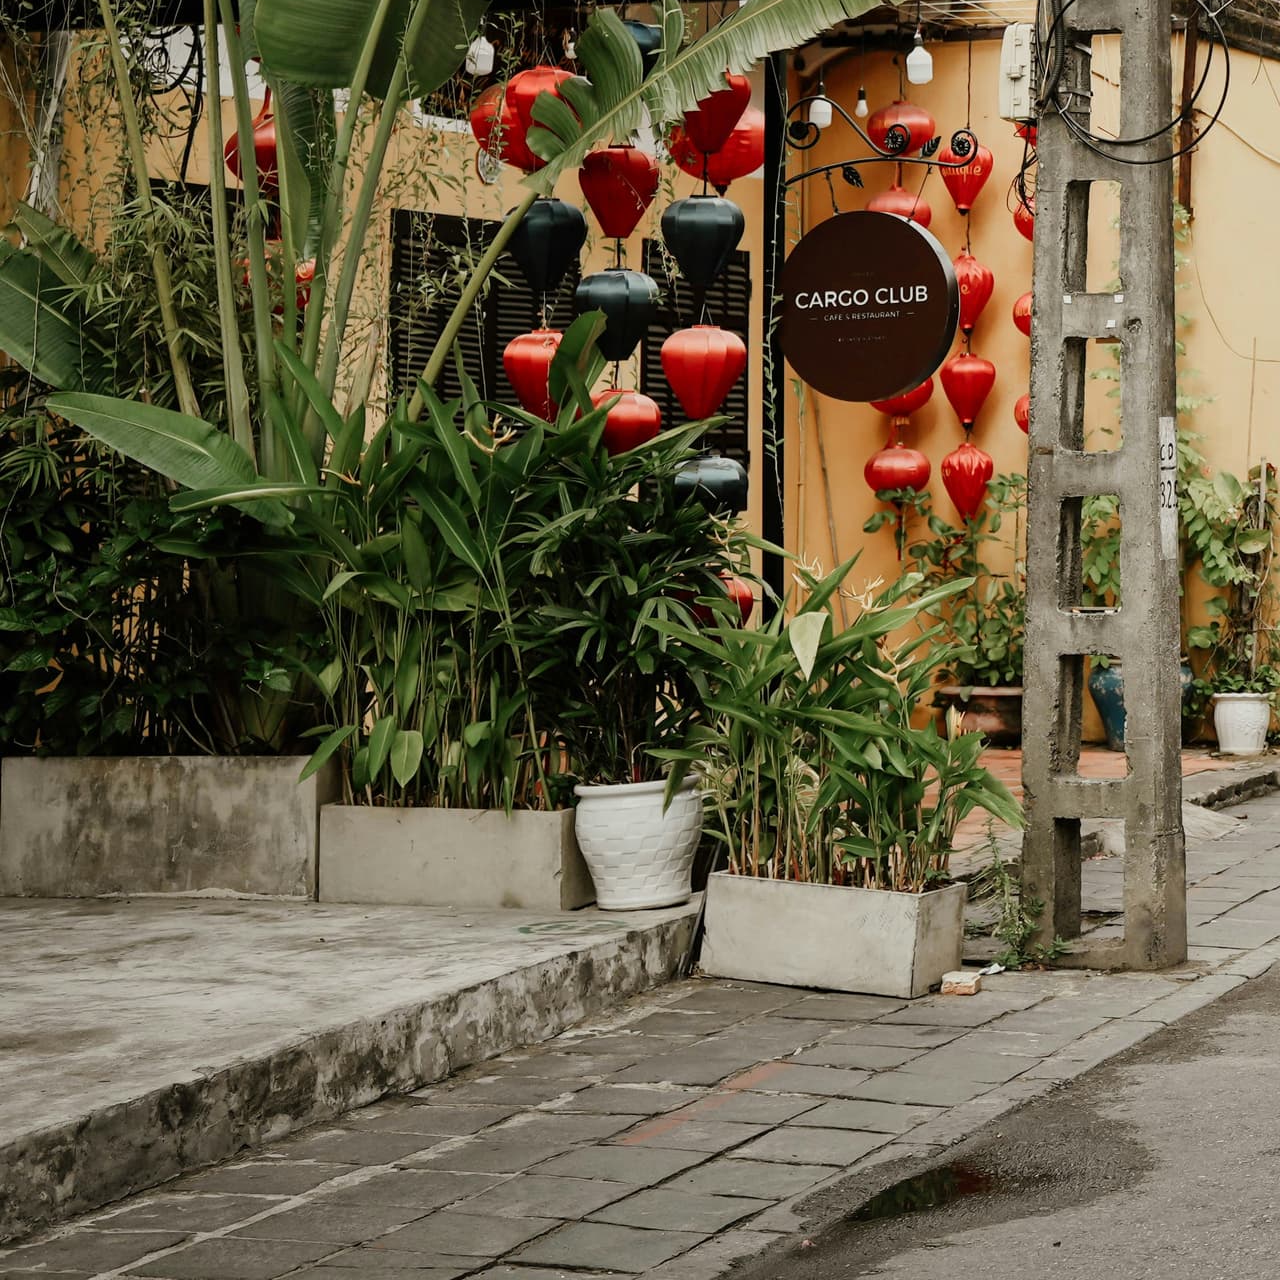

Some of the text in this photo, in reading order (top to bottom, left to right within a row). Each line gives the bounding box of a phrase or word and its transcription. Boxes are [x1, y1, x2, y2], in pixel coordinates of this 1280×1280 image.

[795, 285, 928, 309] CARGO CLUB
[851, 310, 900, 320] RESTAURANT
